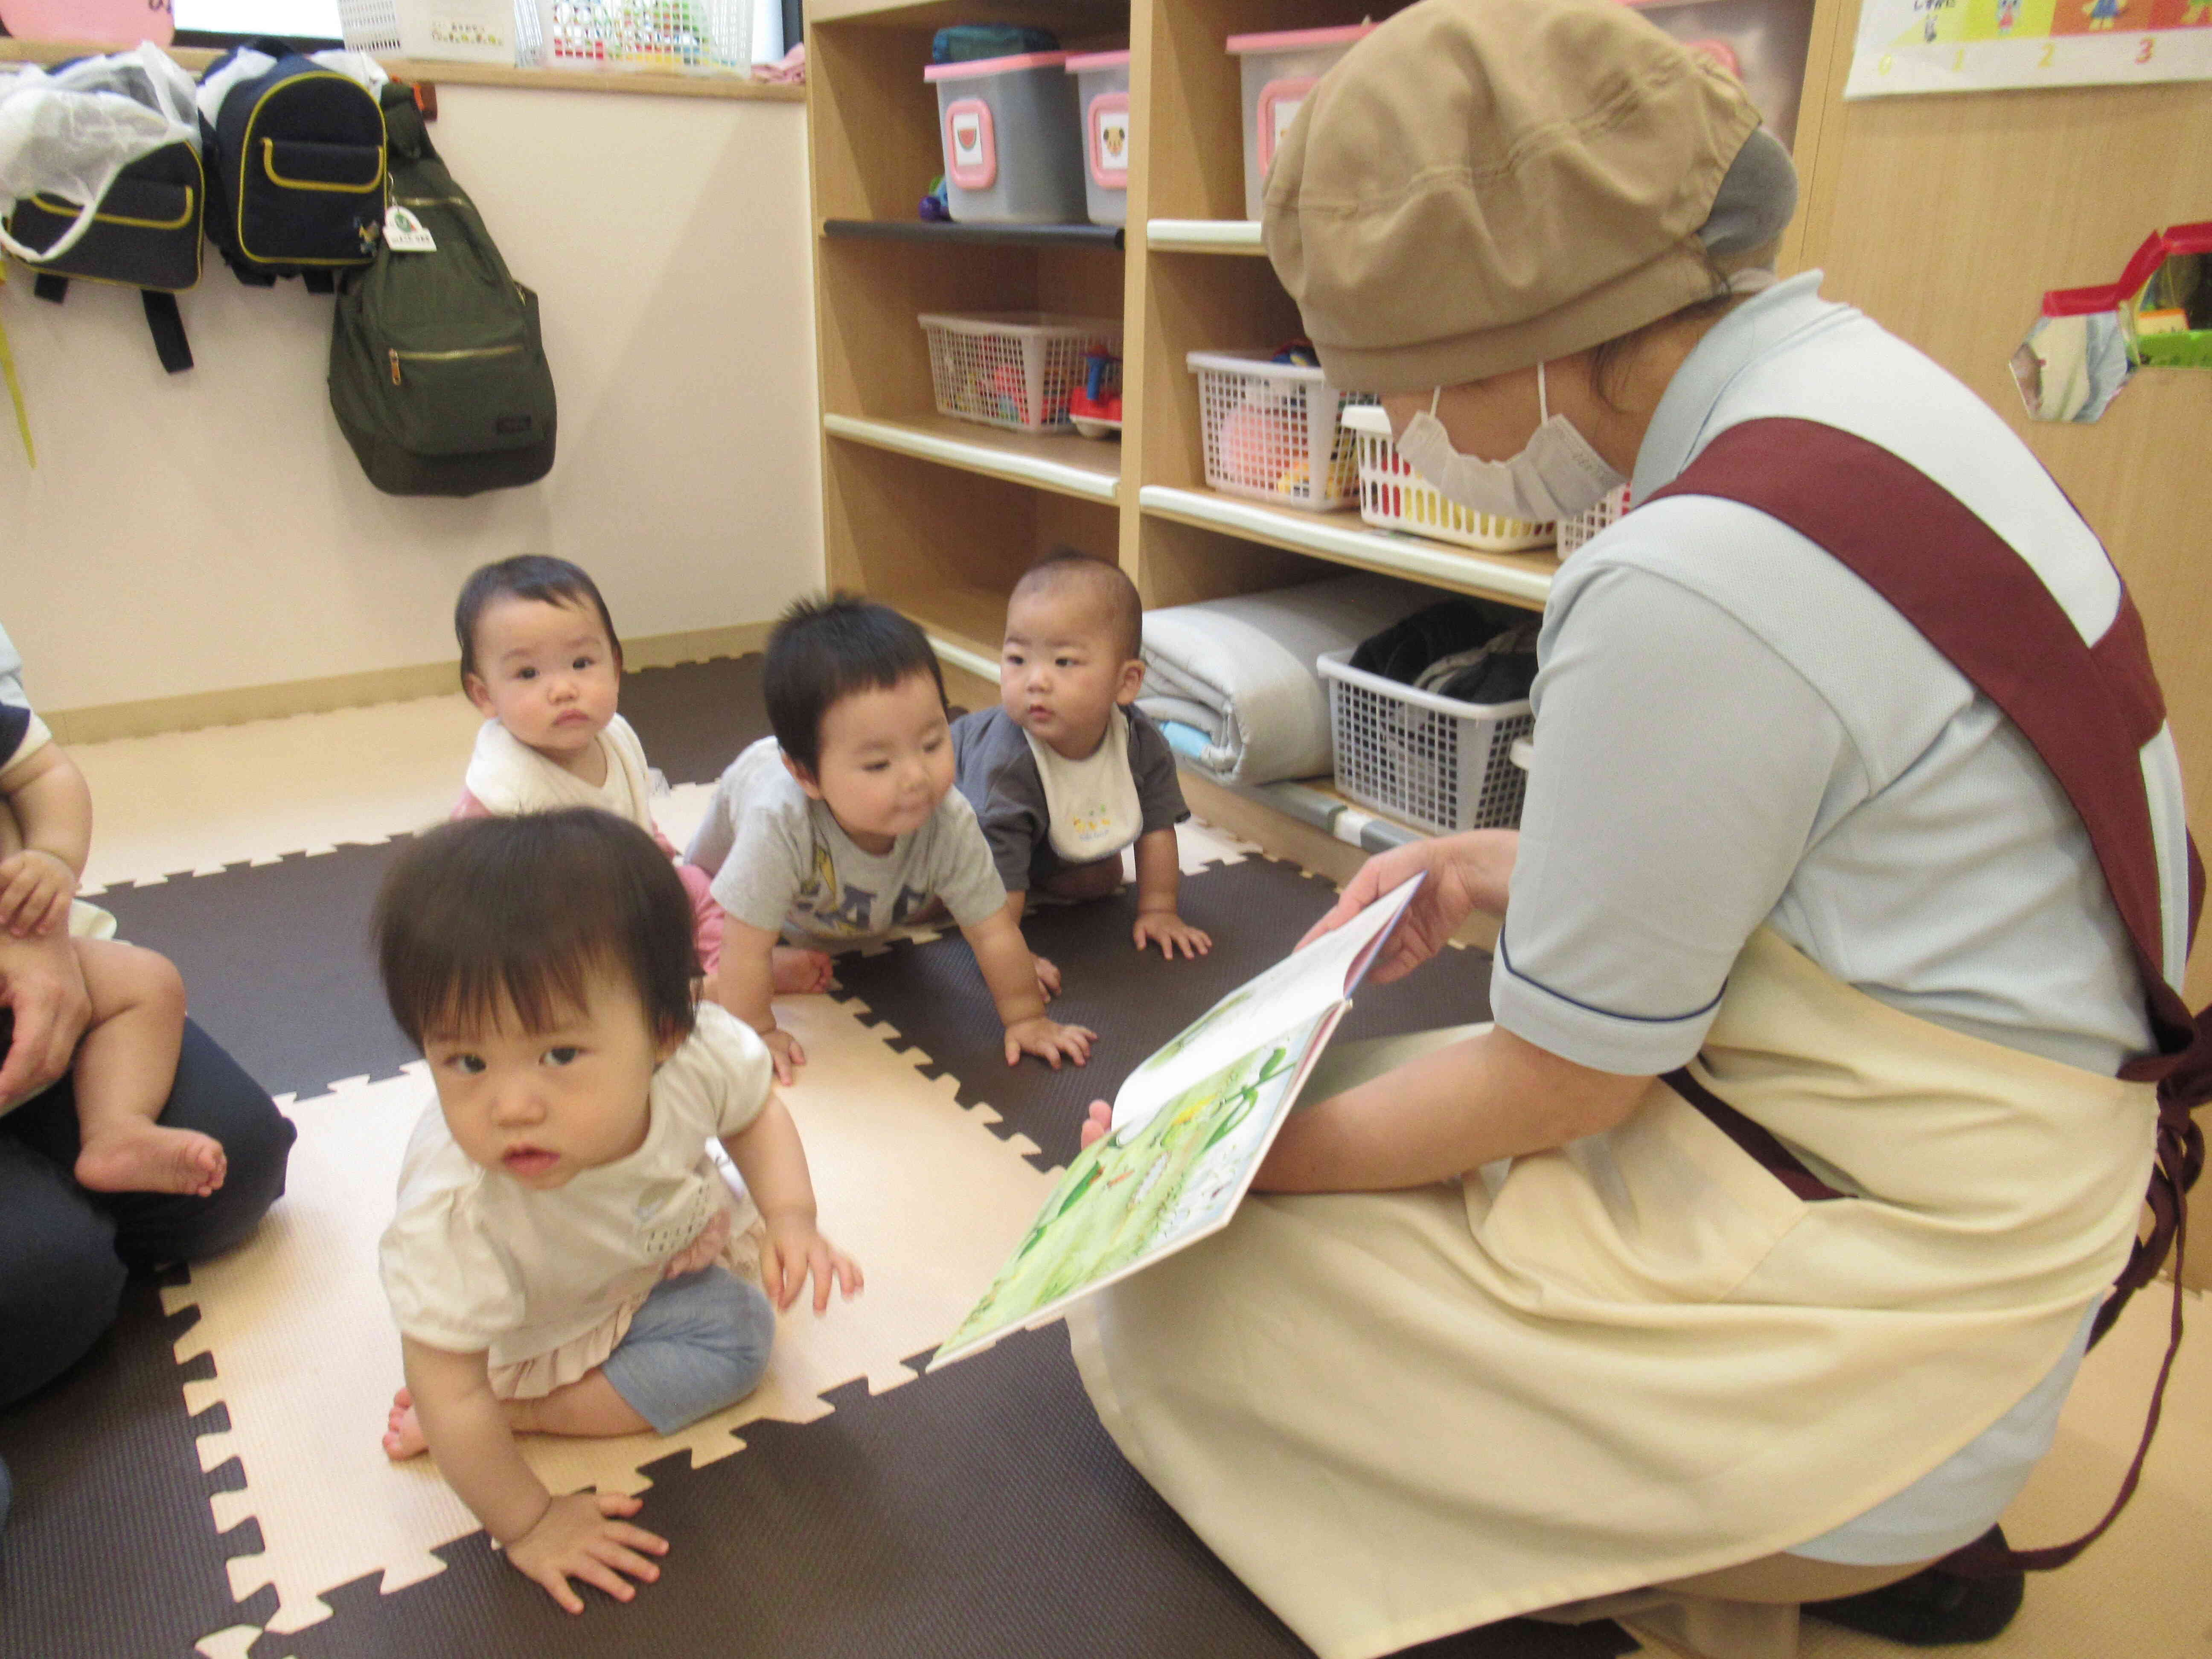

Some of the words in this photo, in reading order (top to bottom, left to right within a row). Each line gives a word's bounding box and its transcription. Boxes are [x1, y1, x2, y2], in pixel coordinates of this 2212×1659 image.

[1878, 53, 1892, 76] 0
[1953, 49, 1965, 72] 1
[2038, 43, 2055, 67] 2
[2135, 37, 2155, 64] 3
